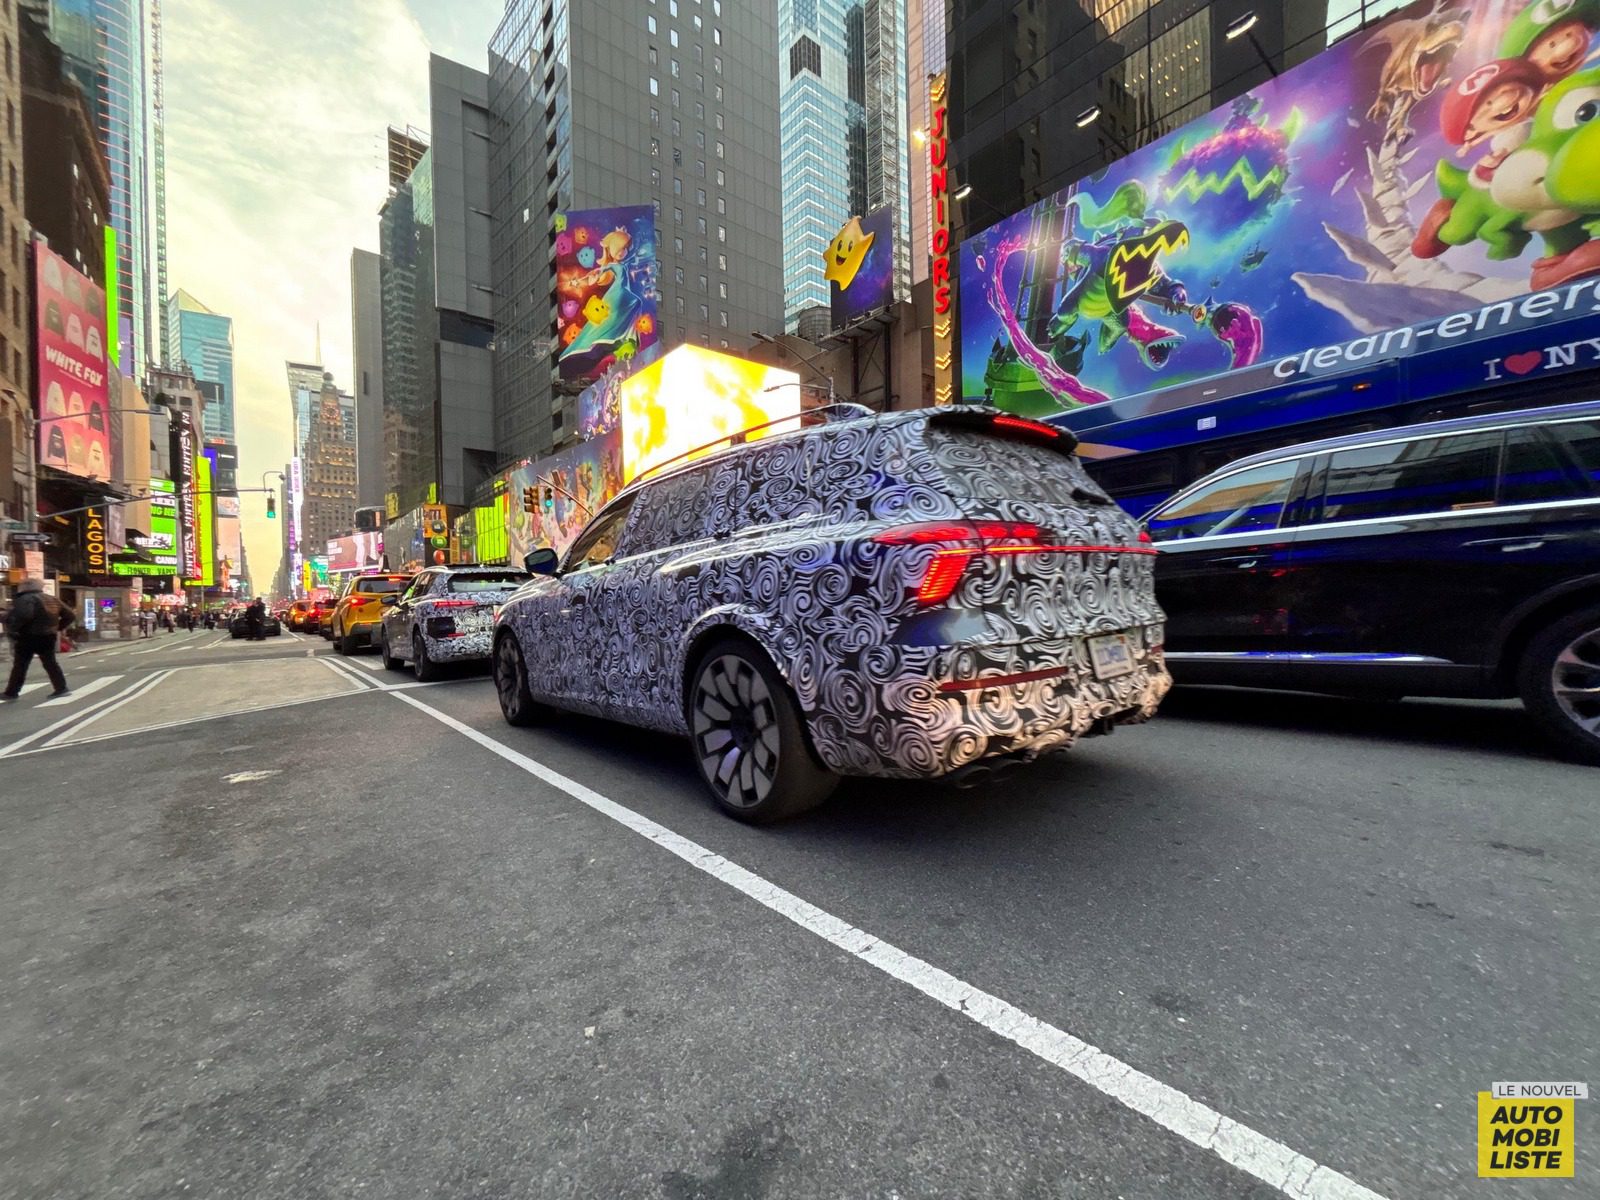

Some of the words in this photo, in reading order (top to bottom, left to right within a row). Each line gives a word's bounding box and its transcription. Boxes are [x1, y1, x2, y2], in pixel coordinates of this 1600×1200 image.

[929, 106, 950, 315] JUNIORS
[46, 344, 83, 378] WHITE
[84, 366, 103, 387] FOX
[1483, 358, 1502, 381] I
[87, 508, 104, 565] LAGOS
